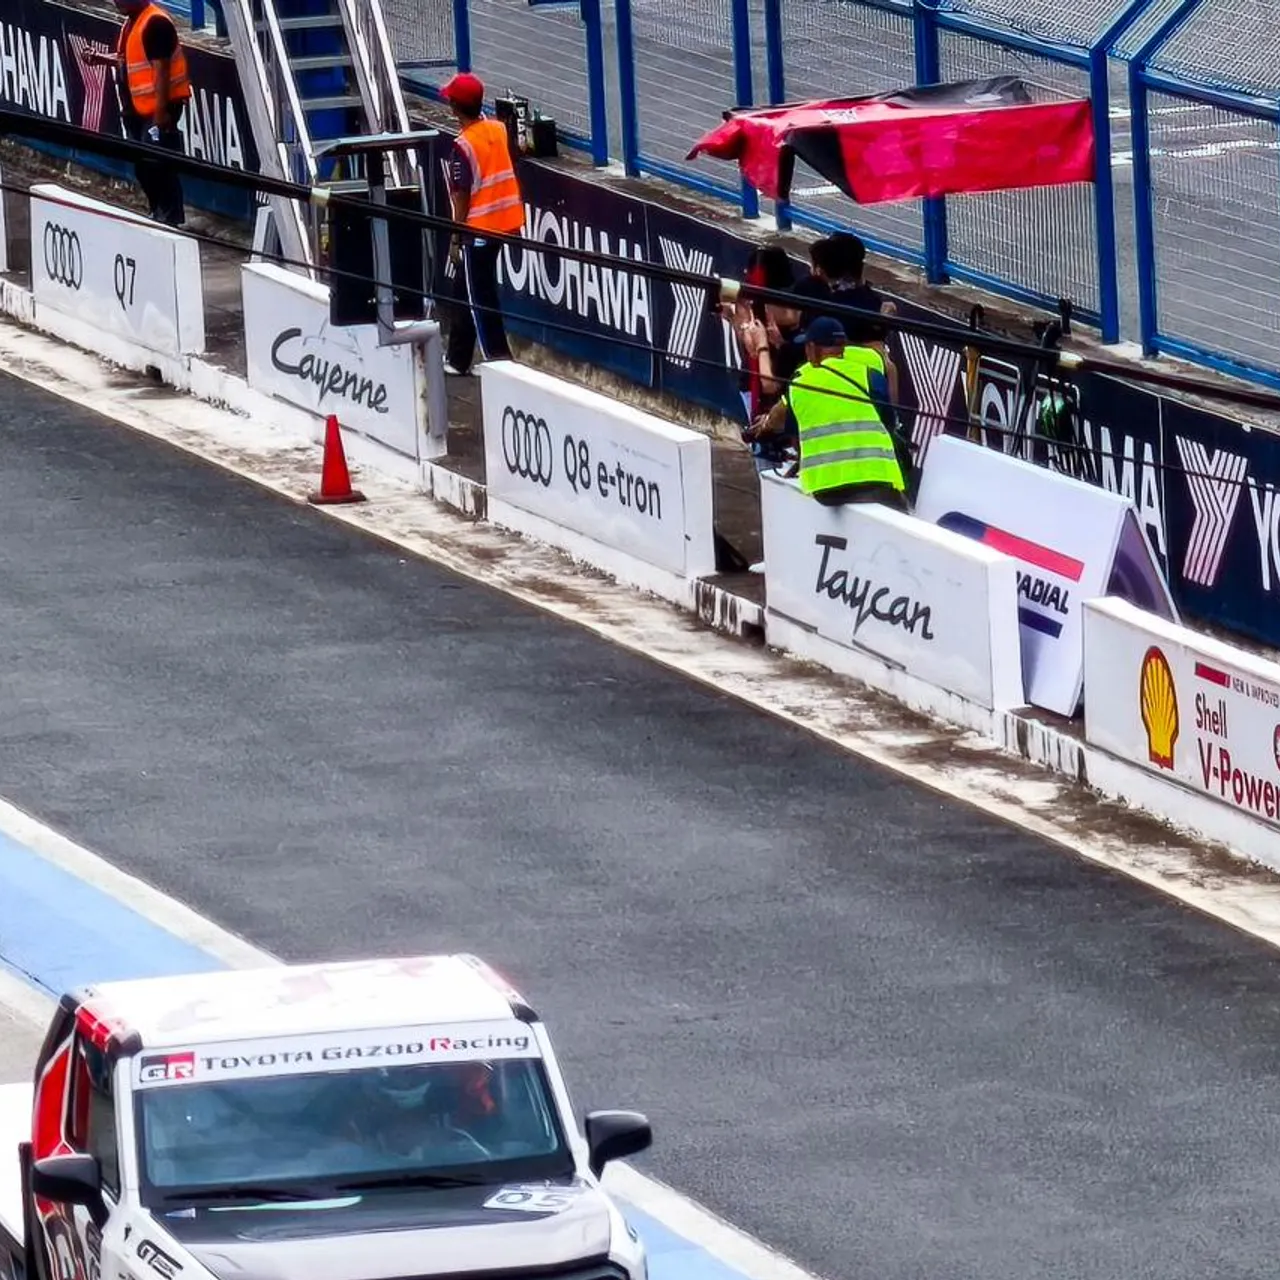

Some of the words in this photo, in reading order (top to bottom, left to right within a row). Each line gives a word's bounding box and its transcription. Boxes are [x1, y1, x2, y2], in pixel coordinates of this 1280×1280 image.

[114, 253, 136, 311] Q7
[271, 327, 389, 413] Cayenne
[563, 434, 591, 496] Q8
[597, 461, 662, 520] e-tron
[815, 534, 935, 641] Taycan
[1016, 570, 1069, 615] ADIAL
[1195, 692, 1228, 740] Shell
[140, 1061, 196, 1083] GR
[200, 1050, 314, 1071] TOYOTA
[322, 1042, 424, 1061] GAZOO
[430, 1034, 529, 1053] Racing
